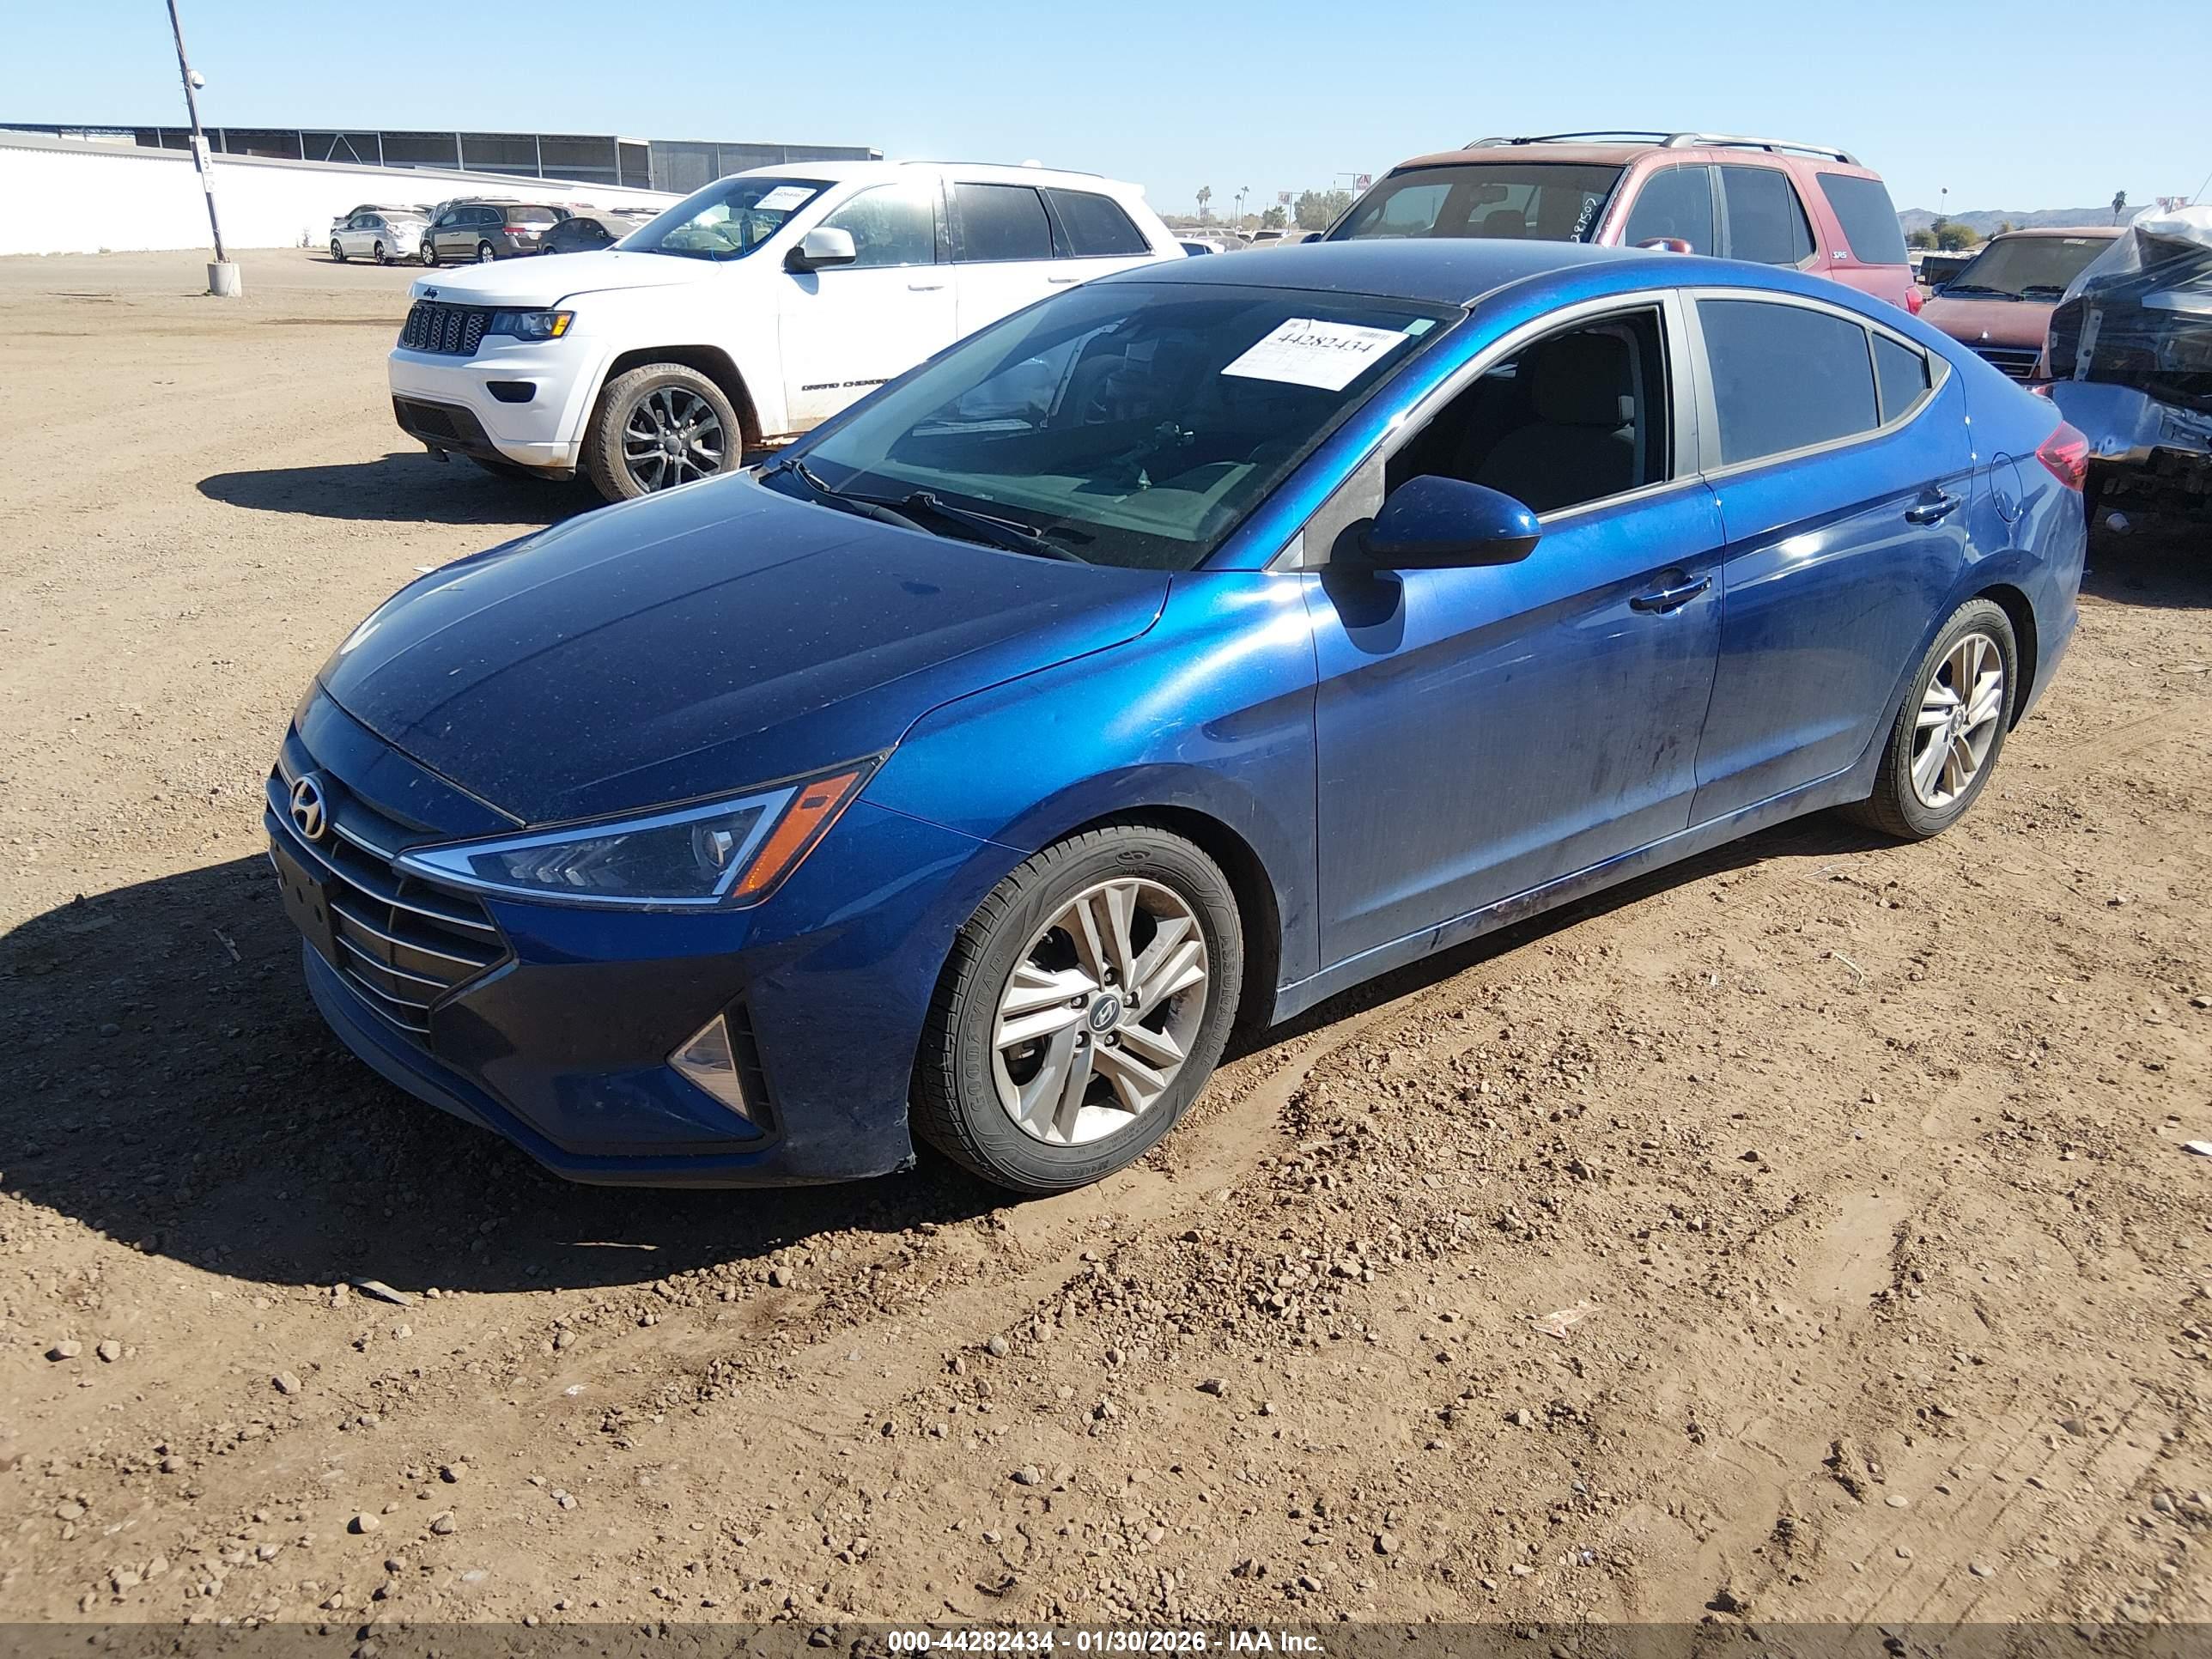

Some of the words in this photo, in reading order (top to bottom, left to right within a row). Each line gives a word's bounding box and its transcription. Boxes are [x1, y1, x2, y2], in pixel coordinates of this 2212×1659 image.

[1278, 332, 1376, 353] 44282434
[965, 950, 1006, 1113] GOODYEAR
[1201, 934, 1236, 1070] ASSURANCE
